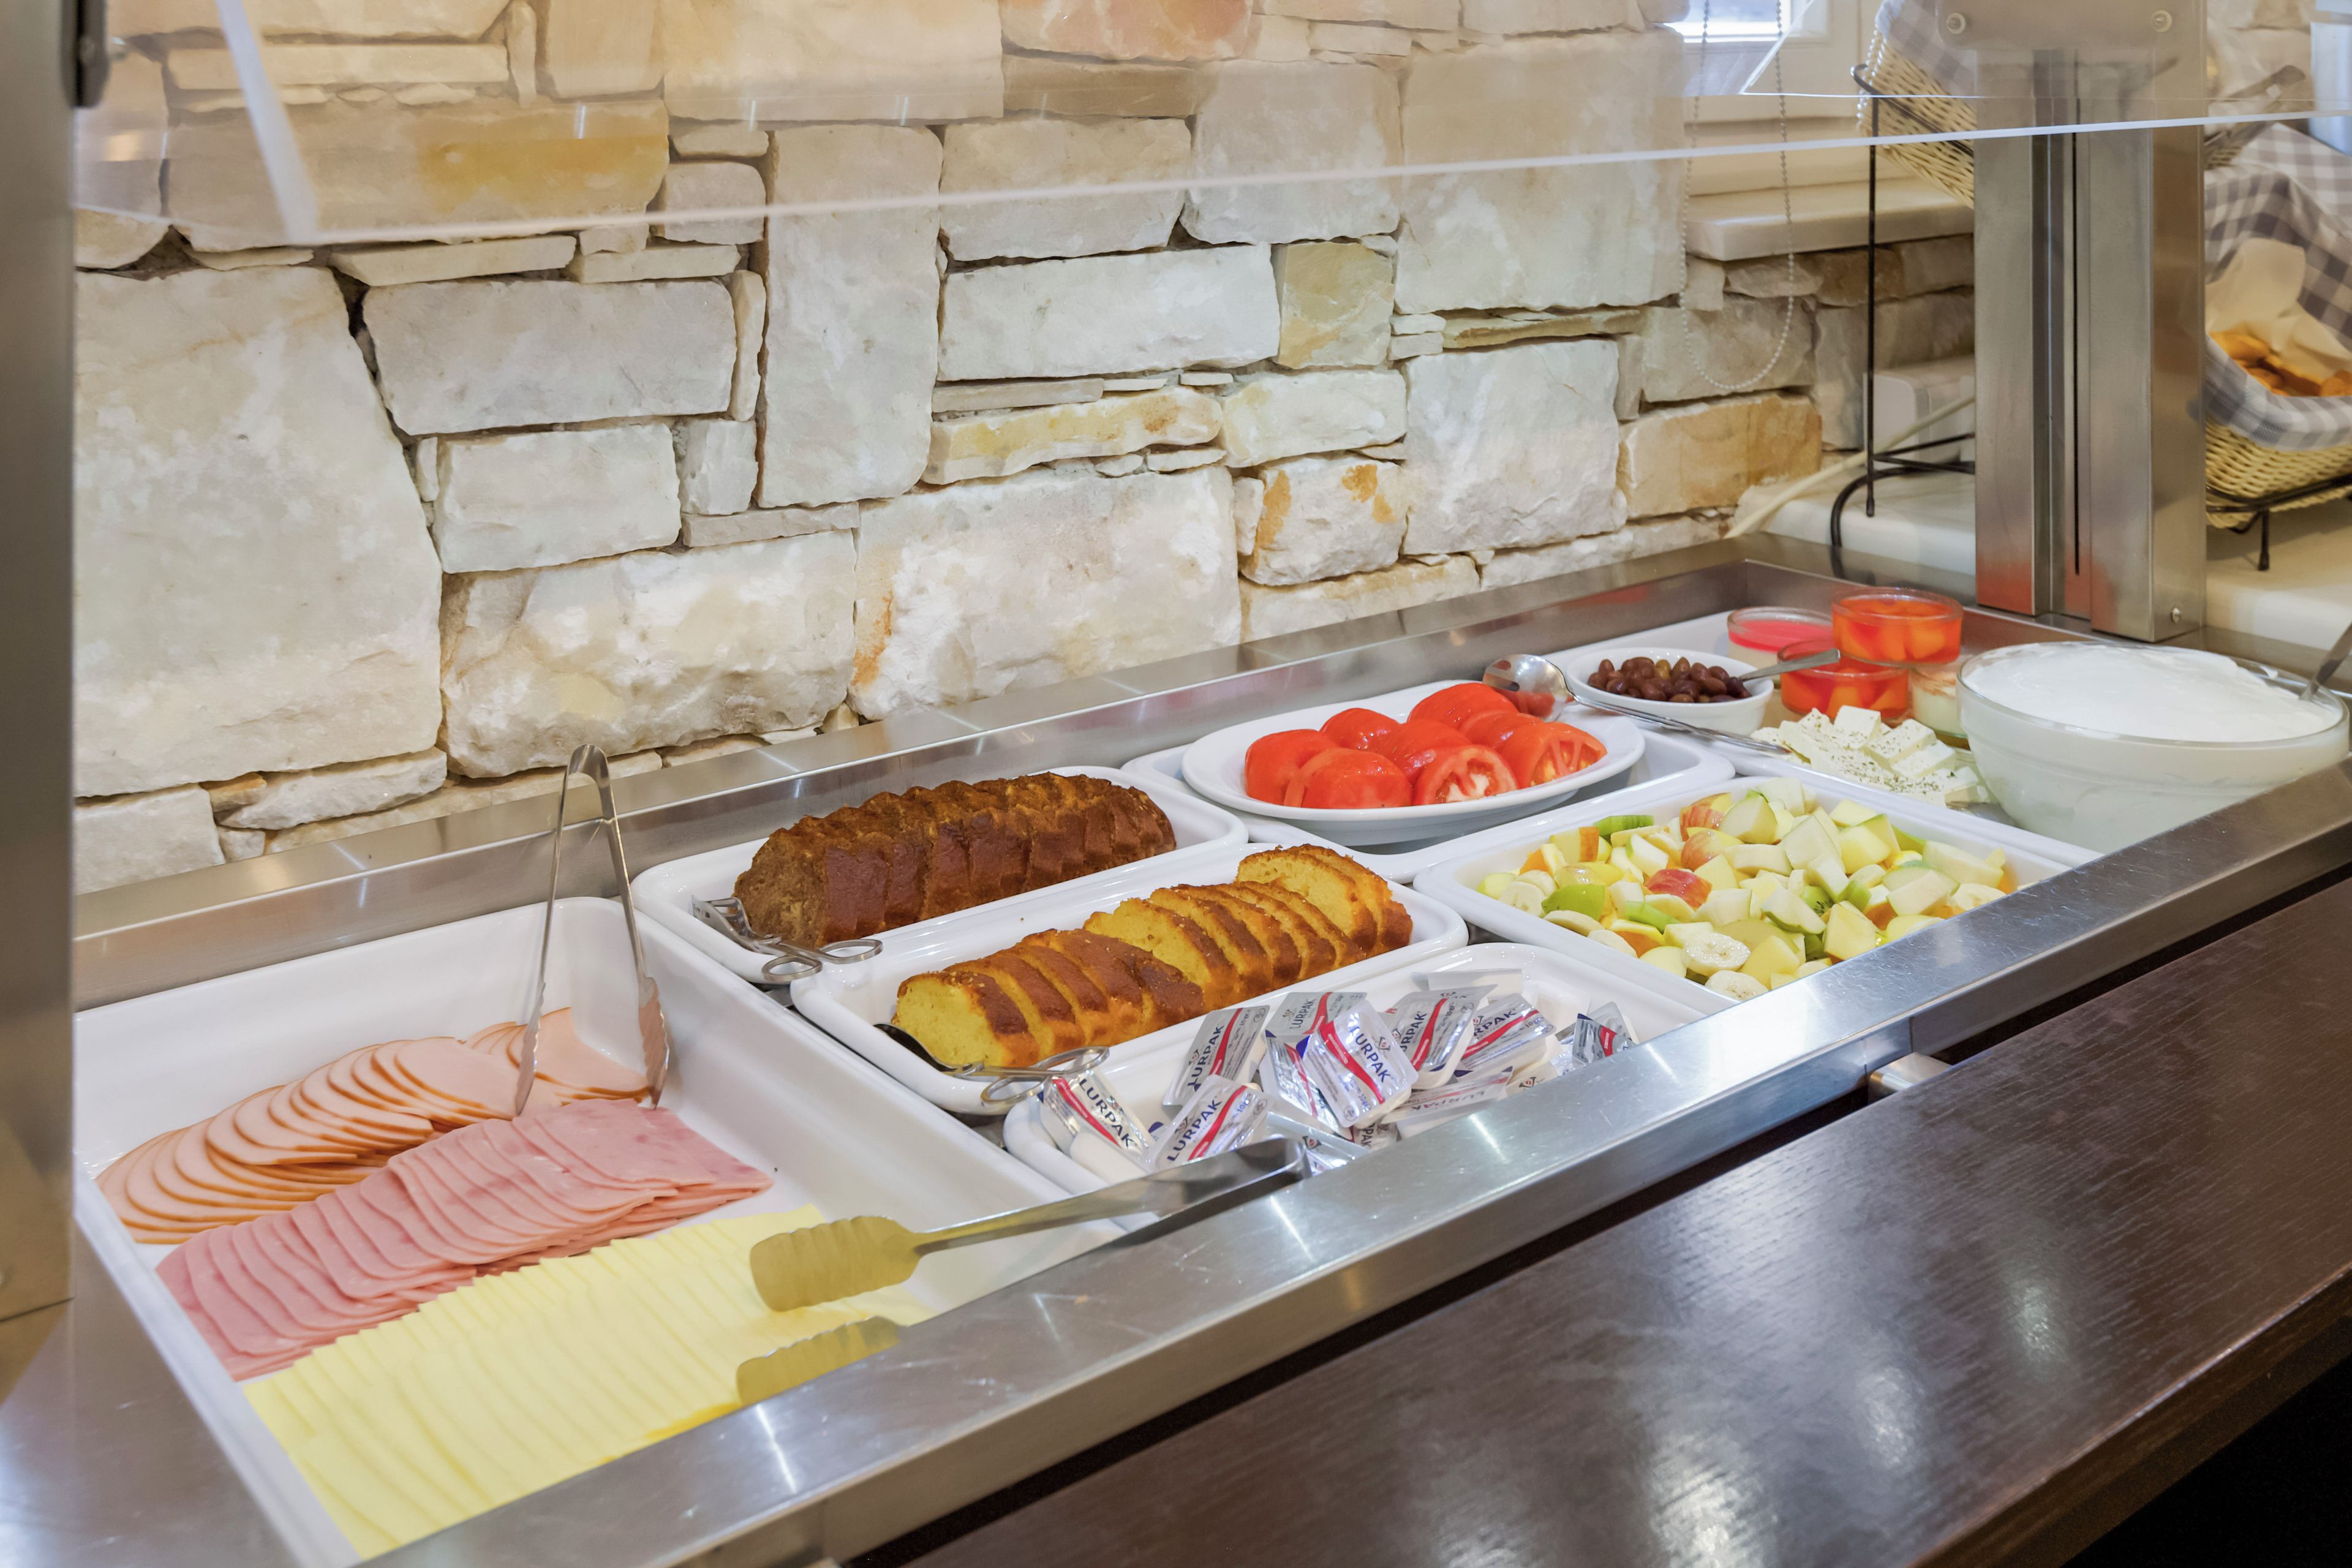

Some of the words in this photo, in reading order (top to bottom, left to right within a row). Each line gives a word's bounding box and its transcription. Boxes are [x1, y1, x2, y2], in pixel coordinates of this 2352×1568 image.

[1289, 998, 1316, 1030] LURPAK
[1400, 1012, 1428, 1052] URPAK
[1473, 1011, 1517, 1037] RPAK
[1187, 1024, 1225, 1087] LURPAK
[1079, 1078, 1134, 1148] LURPAK
[1166, 1099, 1223, 1162] LURPAK
